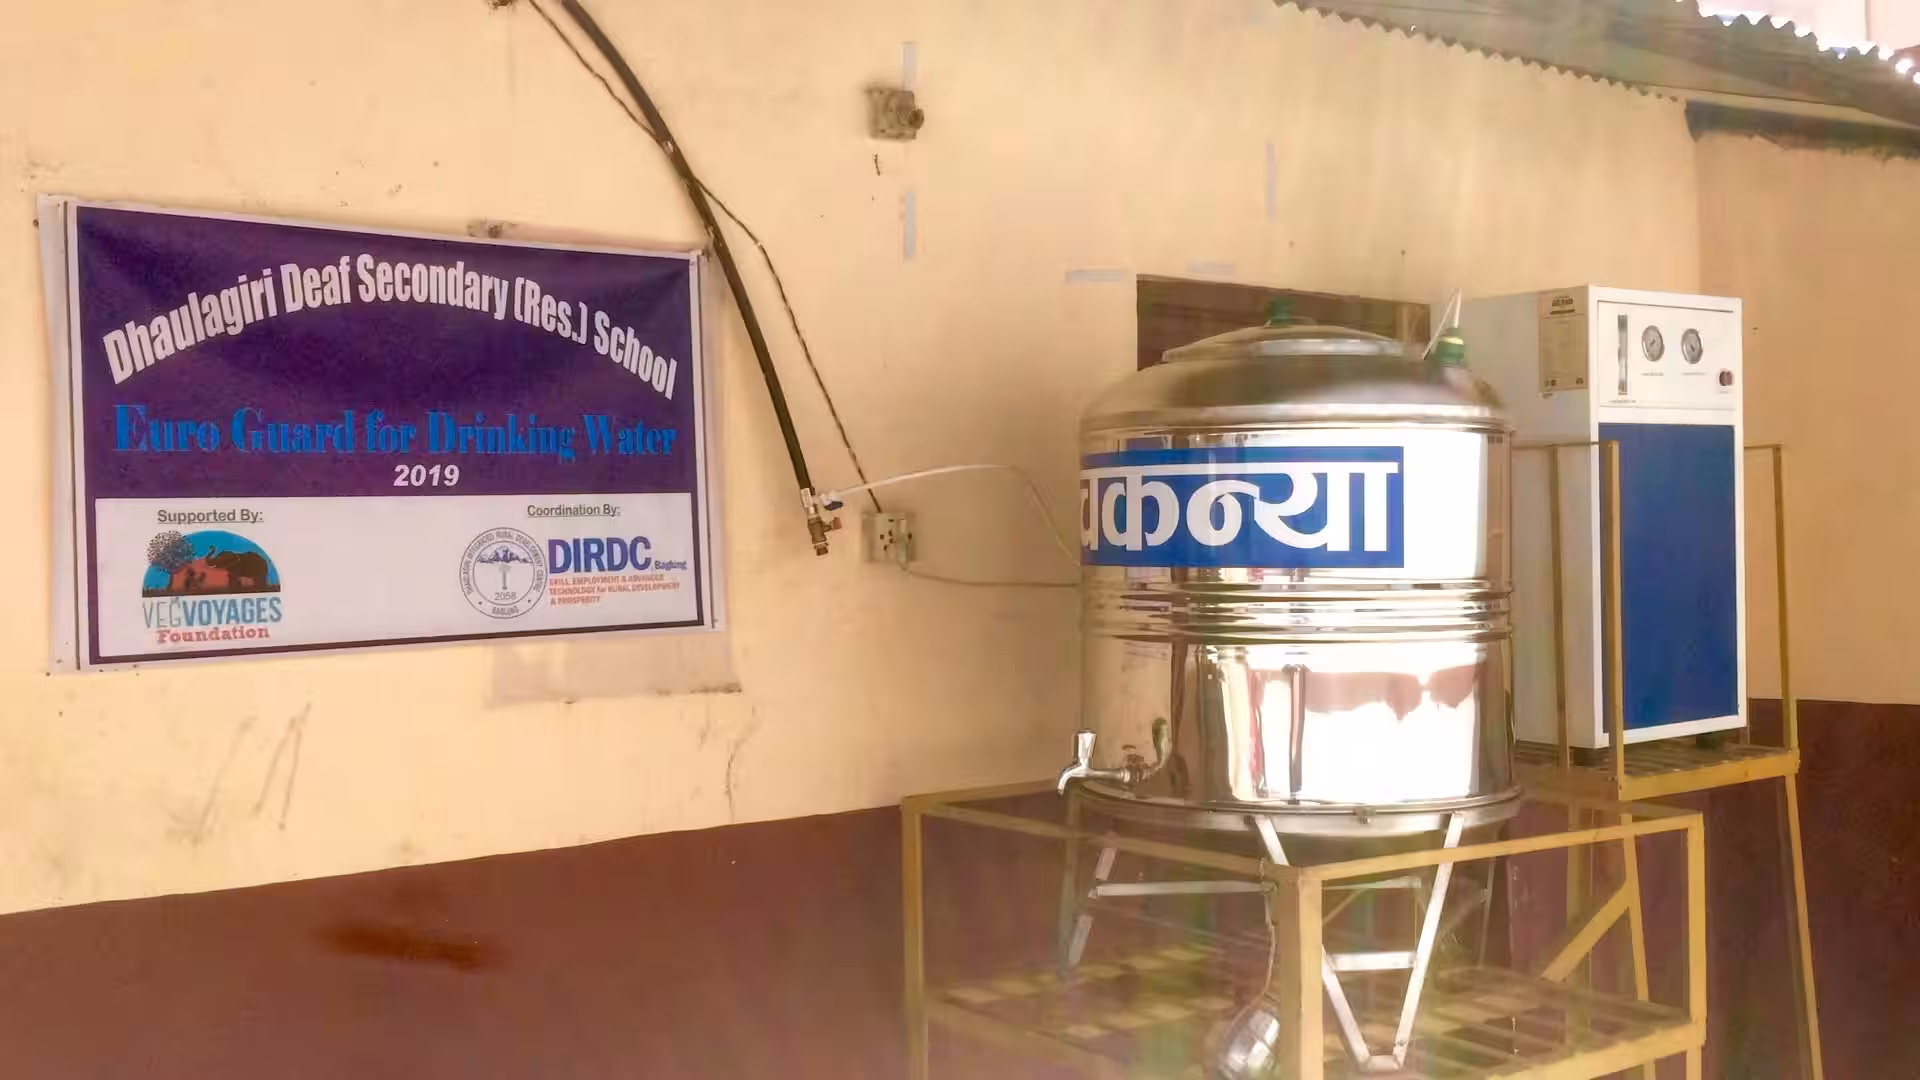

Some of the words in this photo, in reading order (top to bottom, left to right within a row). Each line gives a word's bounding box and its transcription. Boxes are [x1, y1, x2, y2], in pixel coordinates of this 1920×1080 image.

[102, 268, 277, 385] Dhaulagiri
[280, 255, 351, 313] Deaf
[356, 254, 509, 321] Secondary
[514, 276, 588, 345] (Res.)
[593, 310, 678, 401] School
[113, 404, 221, 453] Euro
[231, 406, 355, 454] Guard
[366, 408, 416, 454] for
[425, 409, 576, 463] Drinking
[583, 413, 678, 455] Water
[393, 463, 460, 487] 2019
[157, 509, 236, 524] Supported
[240, 508, 264, 524] By:
[527, 504, 600, 517] Coordination
[603, 503, 621, 517] By:
[494, 591, 517, 601] 2058
[156, 625, 270, 643] Foundation
